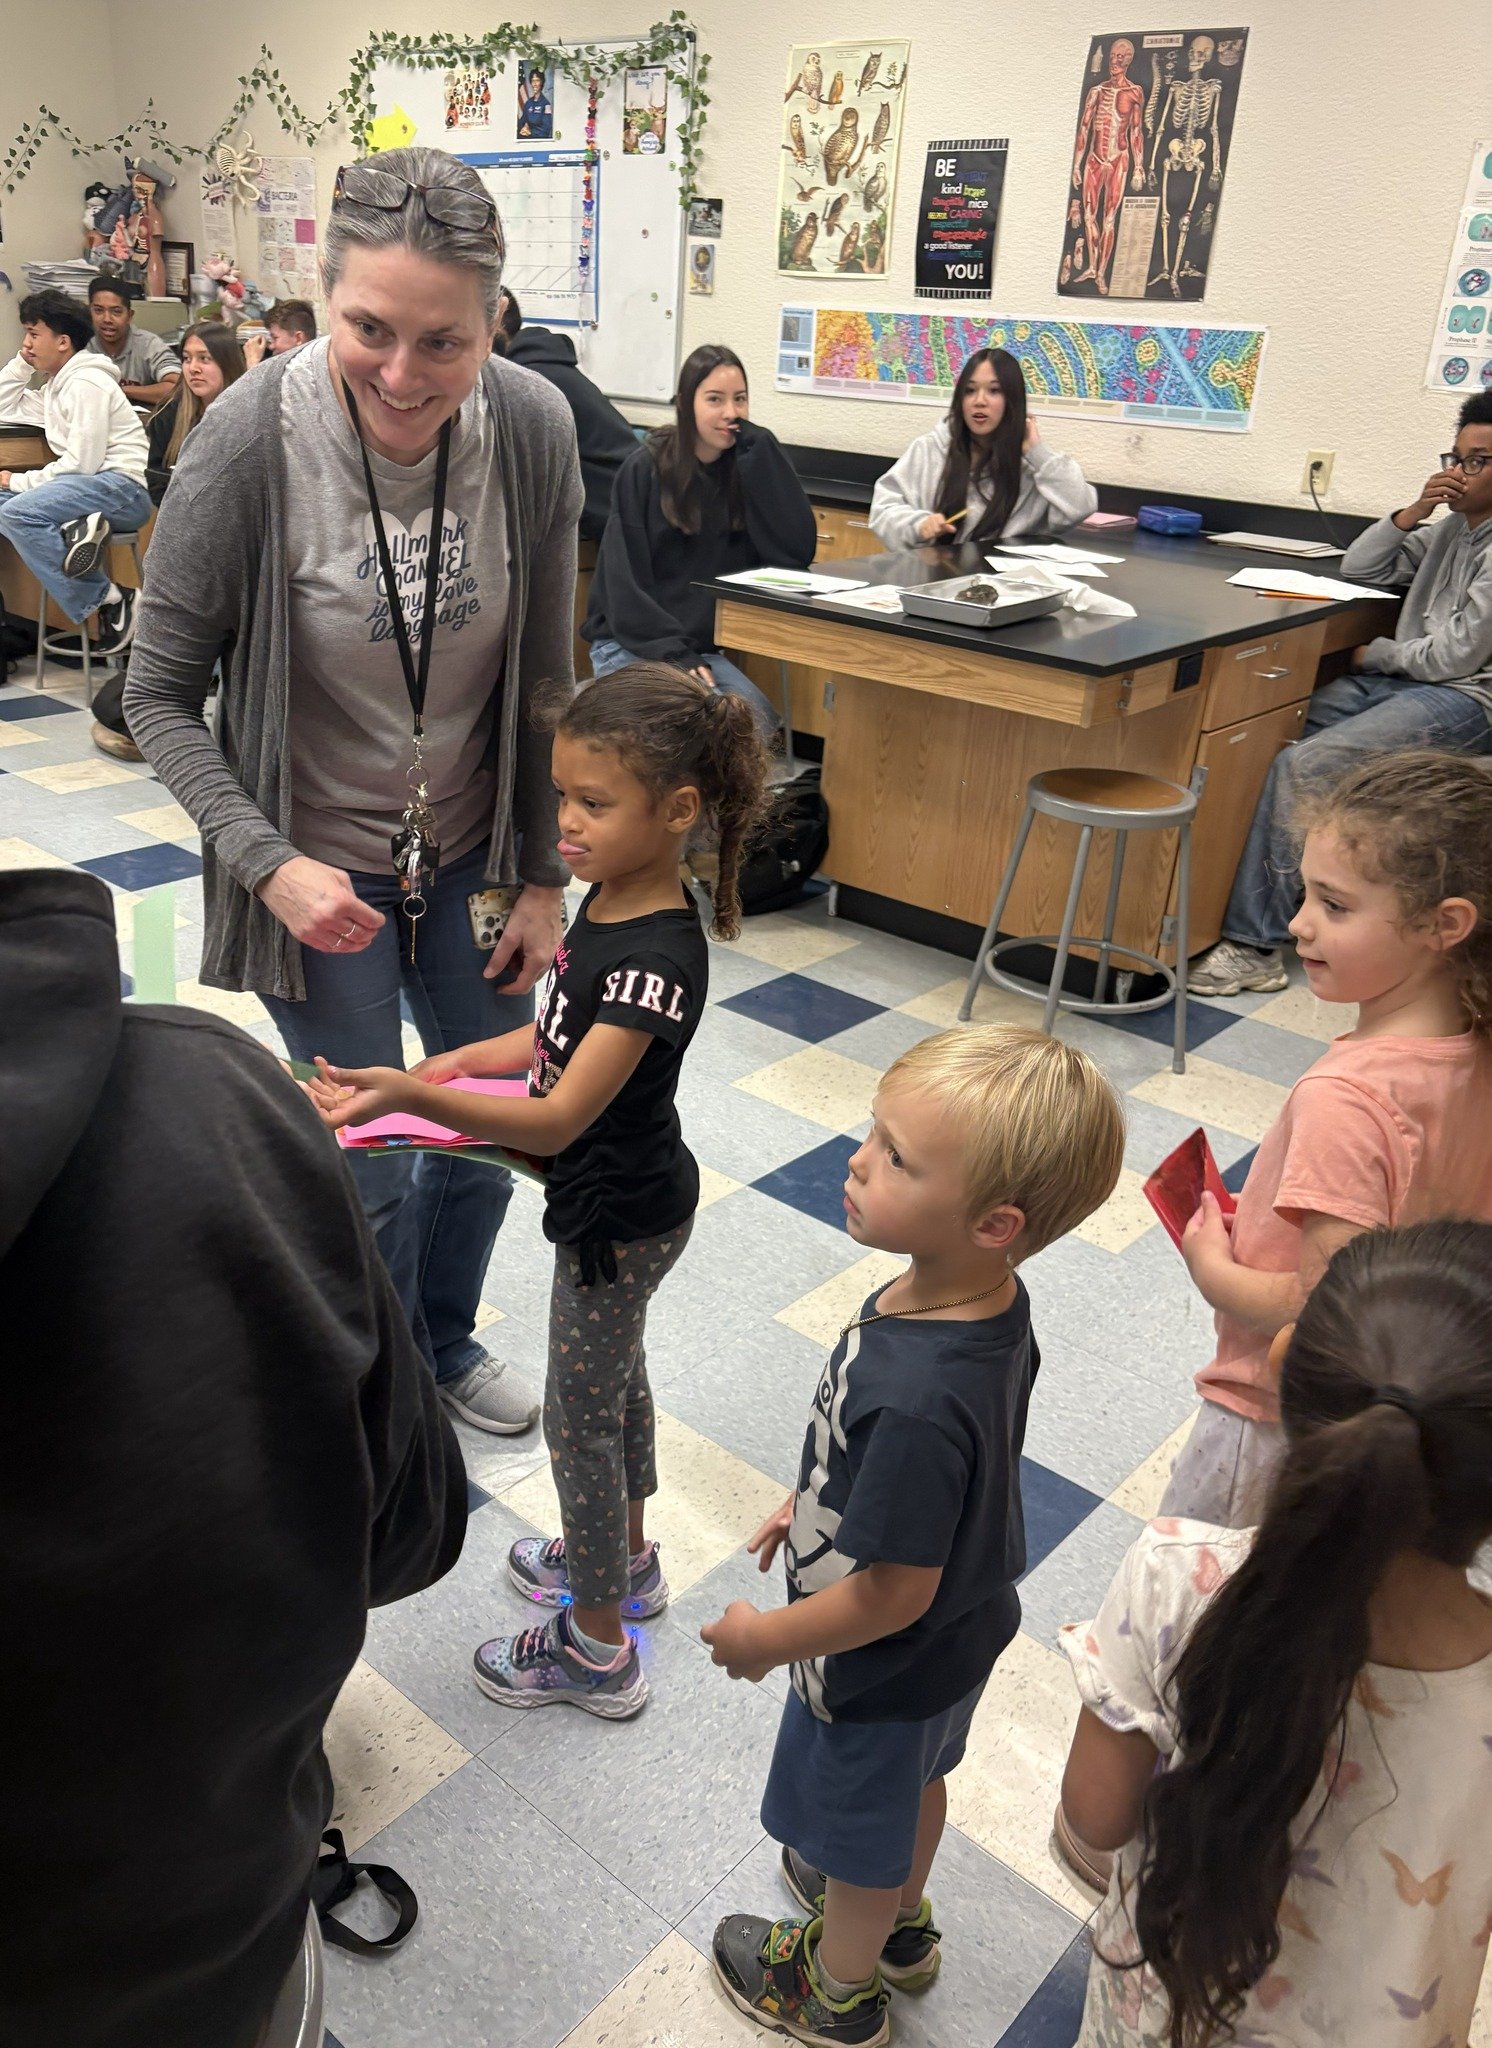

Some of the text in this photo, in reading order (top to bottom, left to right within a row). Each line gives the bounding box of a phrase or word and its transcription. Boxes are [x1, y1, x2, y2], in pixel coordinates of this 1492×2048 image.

[935, 158, 957, 177] BE
[941, 183, 962, 194] kind
[968, 198, 988, 208] nice
[950, 210, 983, 218] CARING
[930, 242, 946, 251] good
[945, 263, 983, 280] YOU!
[357, 517, 469, 580] Hllmrk
[365, 598, 391, 623] is
[434, 575, 479, 603] love
